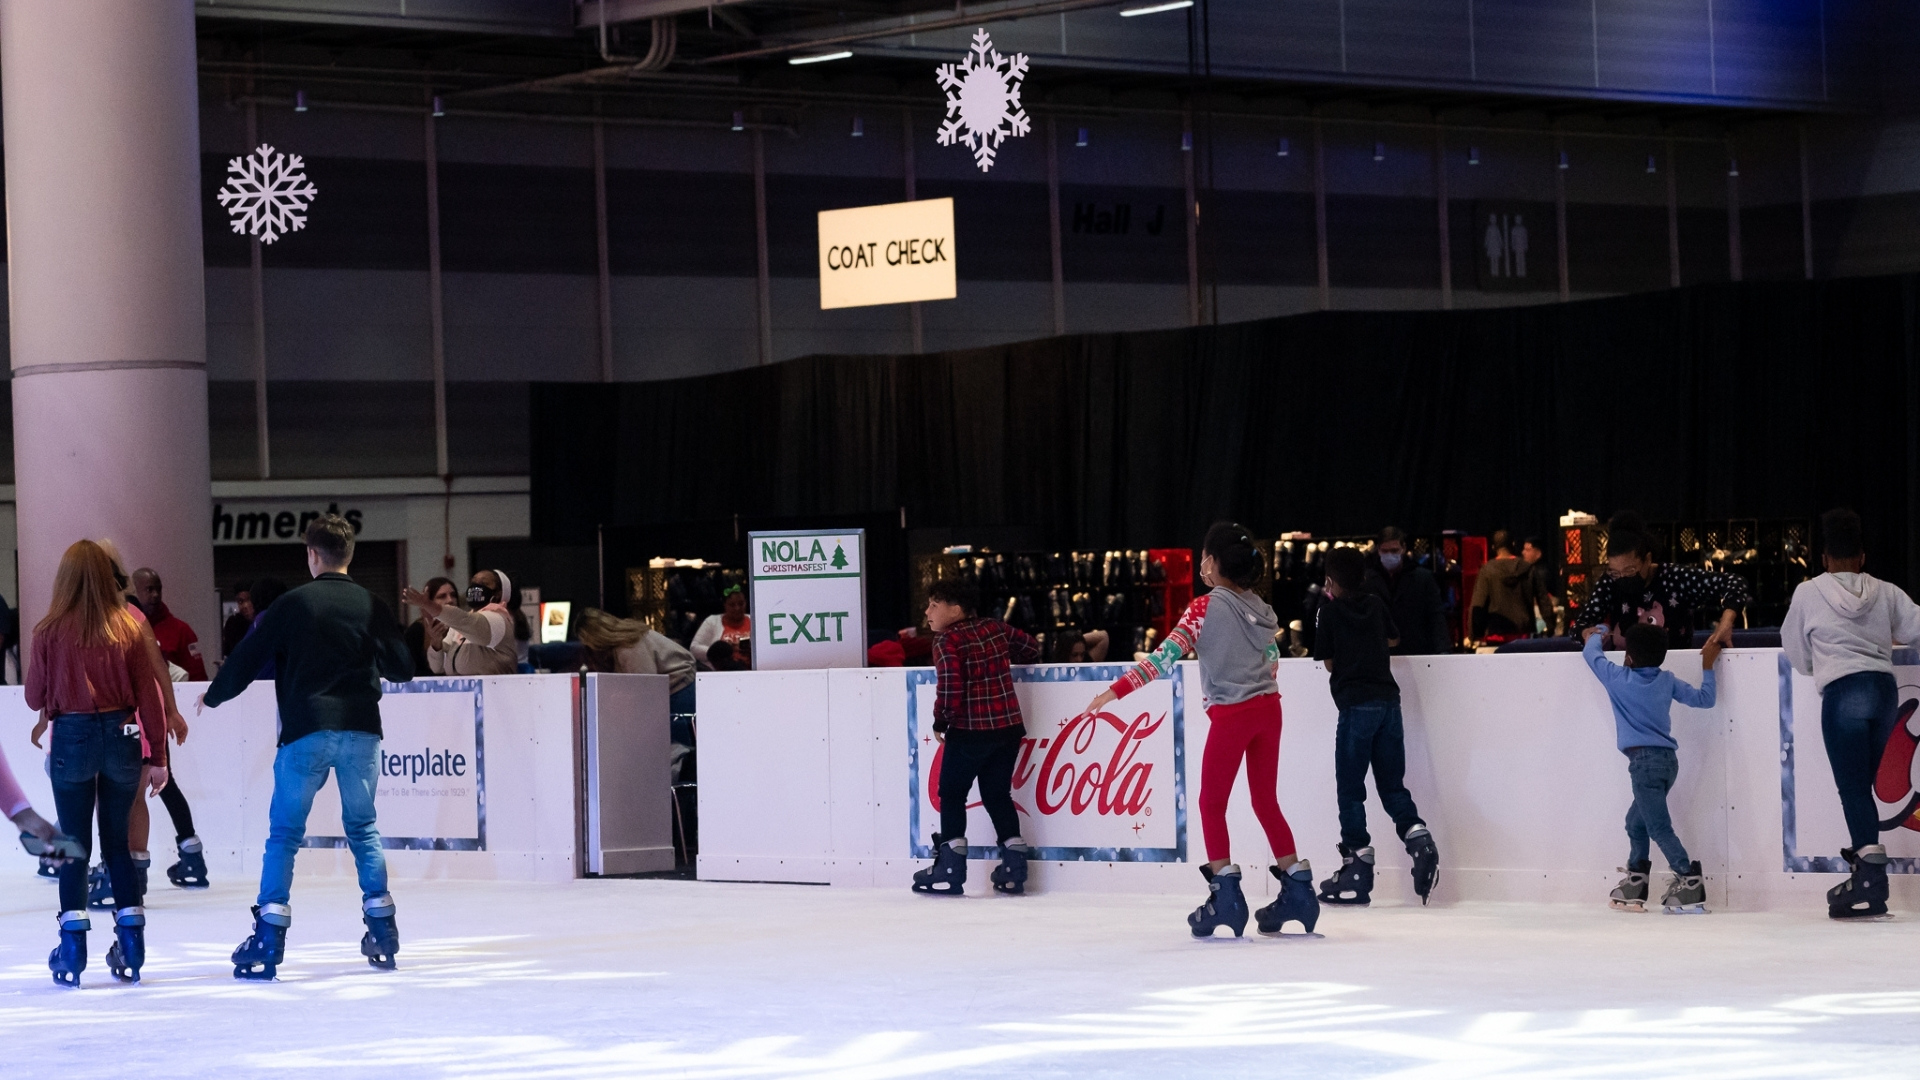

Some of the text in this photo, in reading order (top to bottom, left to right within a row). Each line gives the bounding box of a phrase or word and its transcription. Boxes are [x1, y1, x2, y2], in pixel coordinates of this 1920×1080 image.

[1072, 203, 1165, 236] Hall J
[827, 238, 946, 271] COAT CHECK
[762, 539, 827, 562] NOLA
[762, 563, 828, 573] CHRISTMASFEST
[768, 611, 849, 645] EXIT
[381, 747, 466, 784] terplate
[391, 788, 400, 797] To
[401, 788, 410, 797] Be
[411, 788, 430, 797] There
[431, 788, 449, 797] Since
